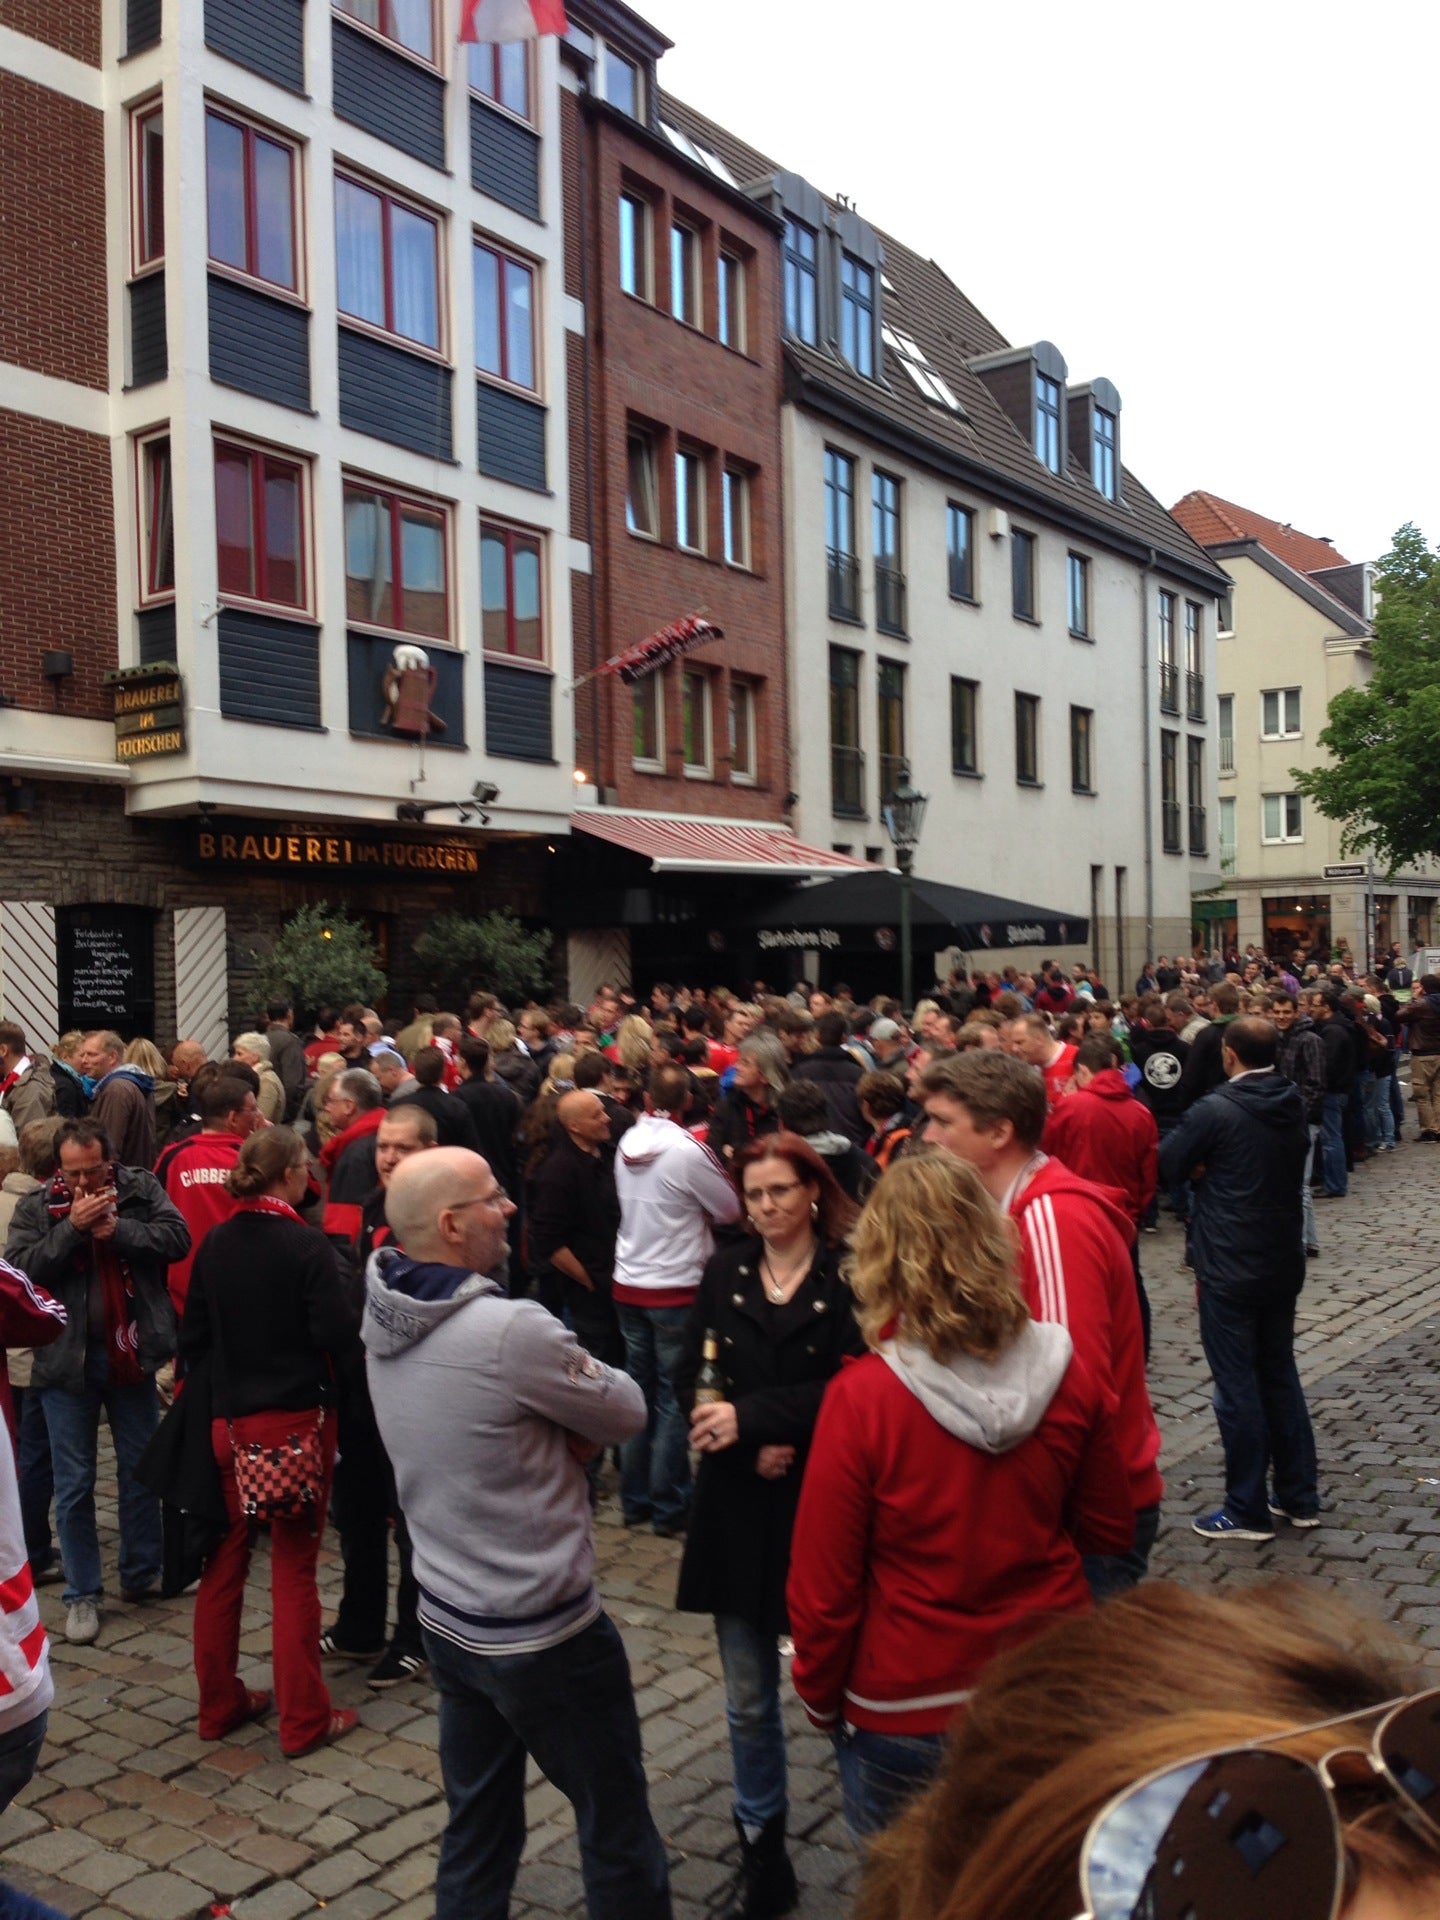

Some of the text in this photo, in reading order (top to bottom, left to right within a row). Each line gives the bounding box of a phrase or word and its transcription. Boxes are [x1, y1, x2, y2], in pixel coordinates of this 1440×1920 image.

[115, 683, 179, 711] BRAUEREI
[140, 713, 155, 728] IM
[200, 833, 352, 864] BRAUEREI
[357, 843, 379, 863] IM
[180, 1168, 231, 1188] CUBBE
